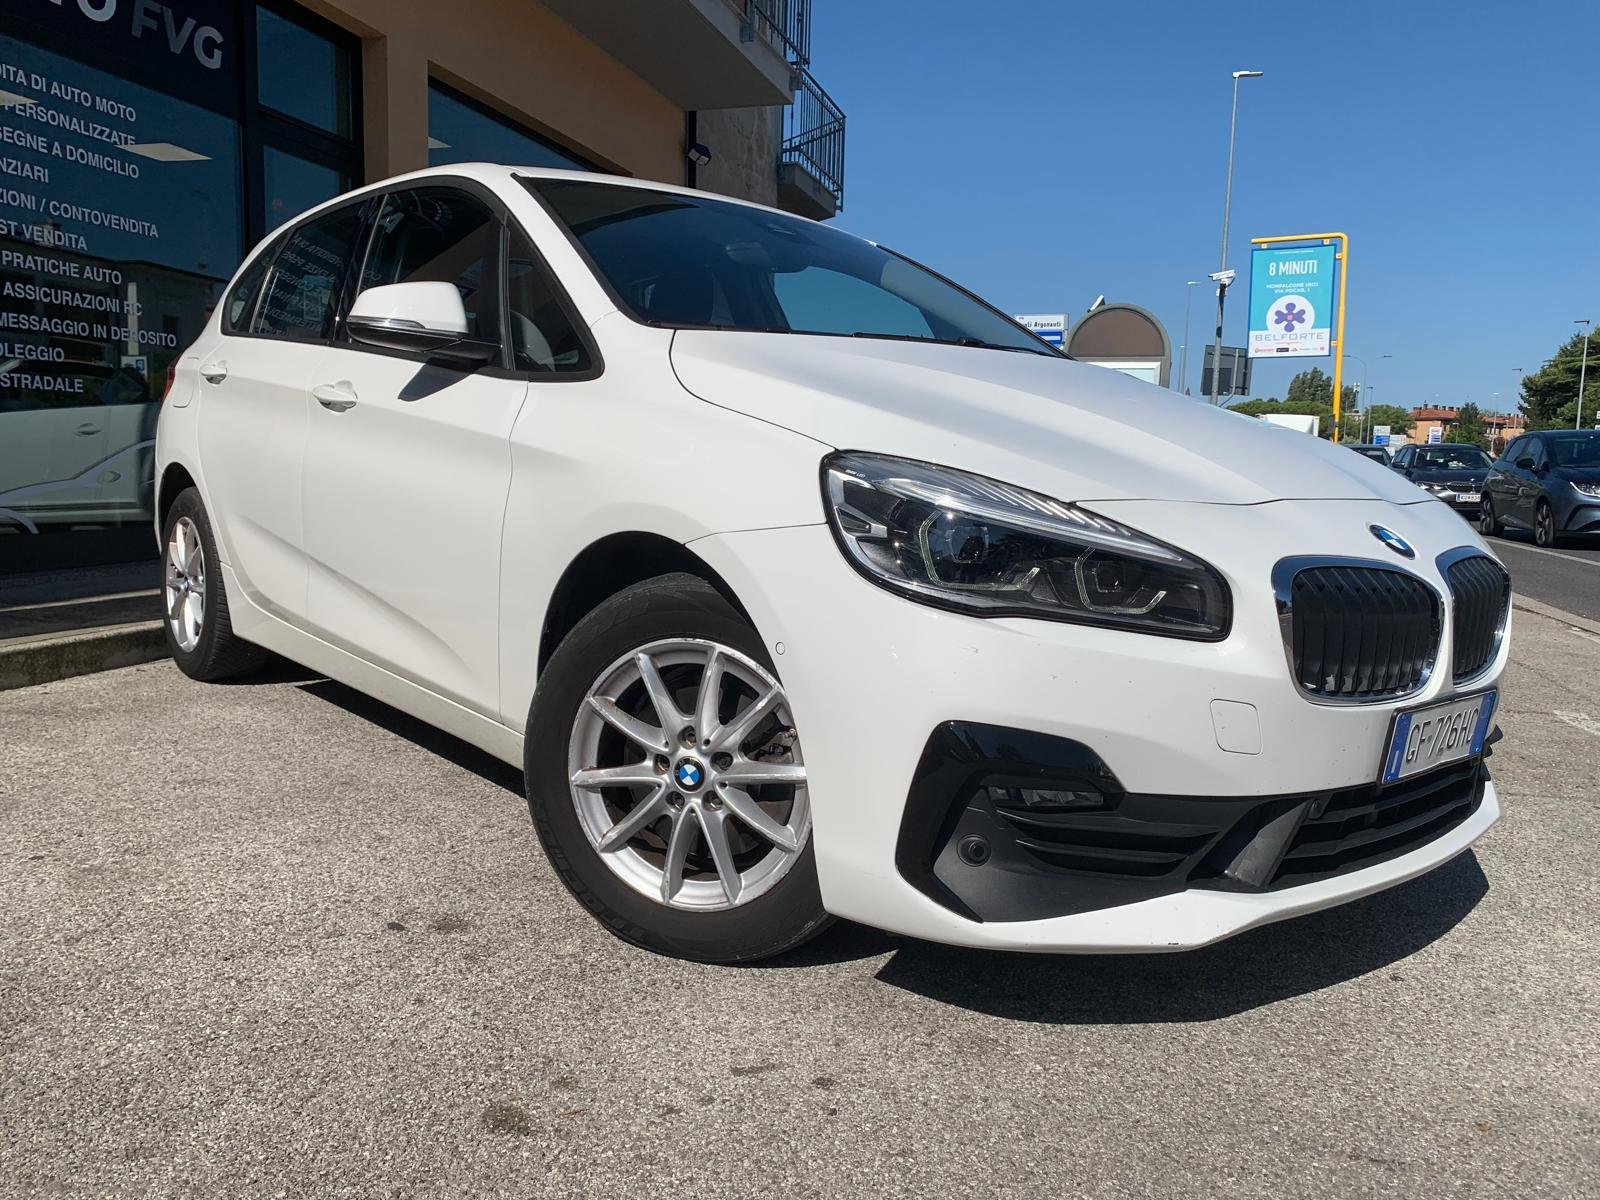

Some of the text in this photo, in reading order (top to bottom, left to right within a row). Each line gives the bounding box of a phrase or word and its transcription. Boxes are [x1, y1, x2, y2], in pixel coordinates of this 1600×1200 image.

[132, 0, 225, 70] FVG
[31, 74, 47, 92] DI
[51, 82, 92, 107] AUTO
[95, 96, 136, 122] MOTO
[51, 141, 63, 157] A
[66, 144, 139, 178] DOMICILIO
[39, 198, 46, 212] /
[49, 200, 159, 238] CONTOVENDITA
[22, 223, 88, 250] VENDITA
[2, 250, 122, 285] PRATICHE AUTO
[1269, 260, 1318, 276] 8 MINUTI
[3, 281, 143, 316] ASSICURAZIONI RC
[93, 323, 108, 339] IN
[111, 326, 177, 347] DEPOSITO
[1255, 332, 1324, 342] BELFORTE
[0, 372, 84, 393] STRADALE
